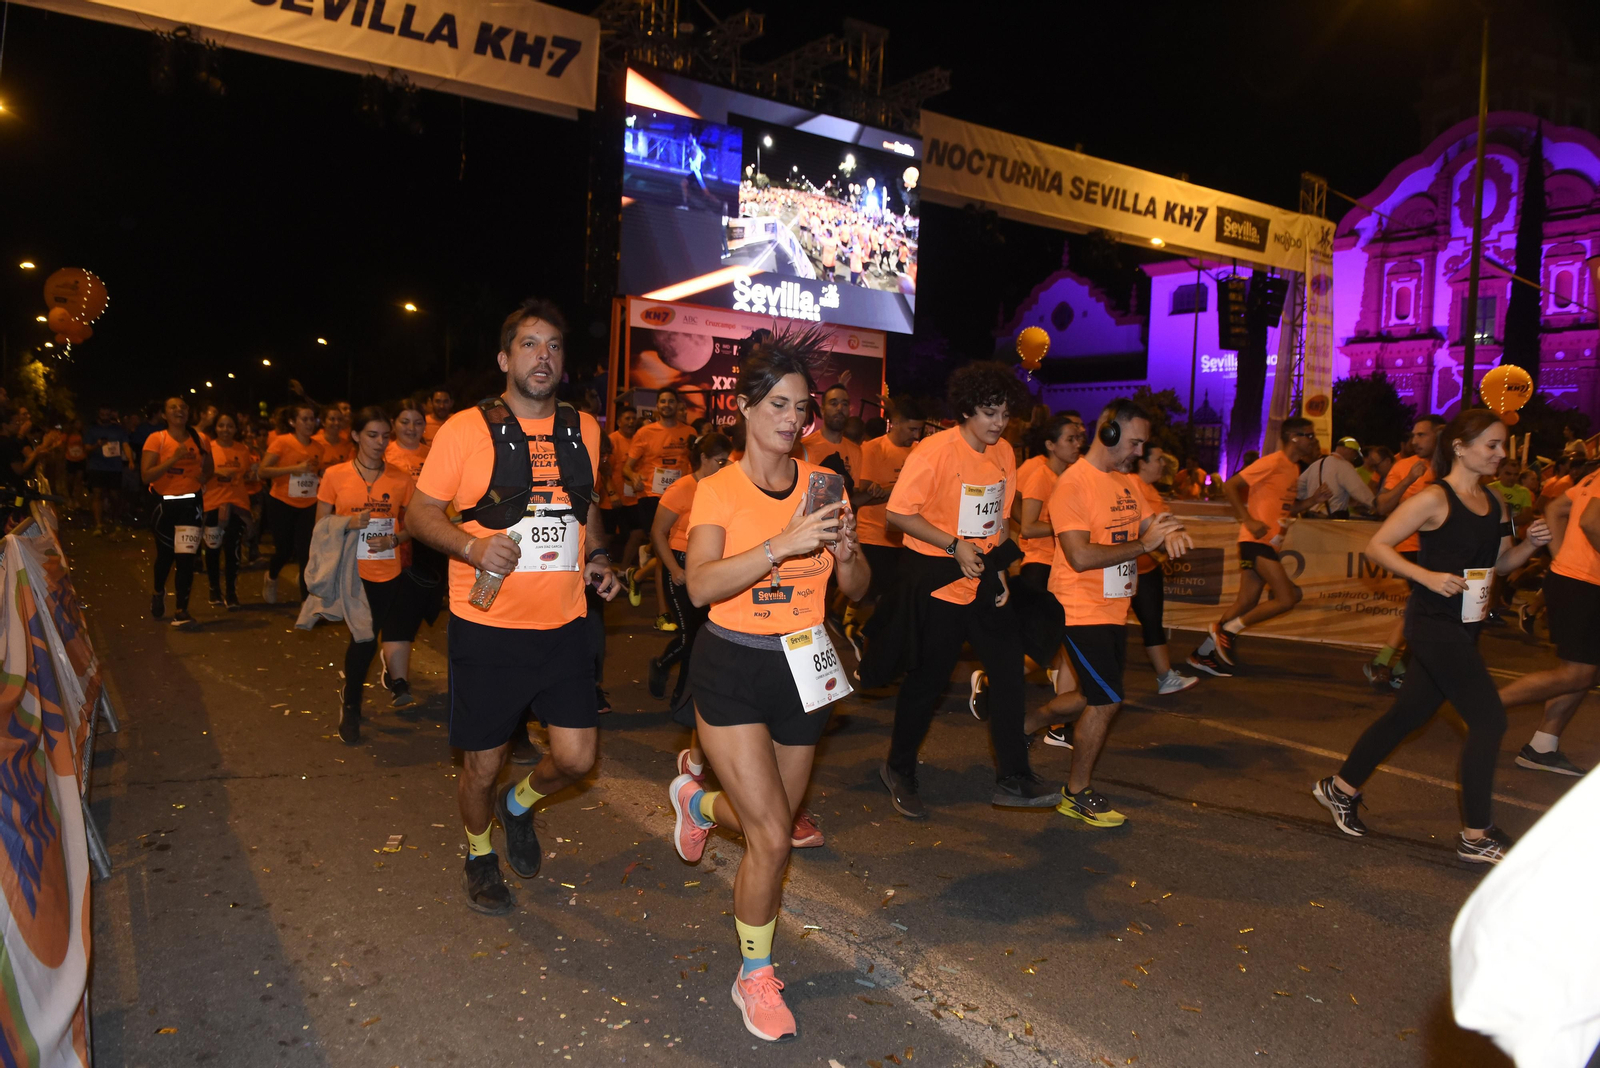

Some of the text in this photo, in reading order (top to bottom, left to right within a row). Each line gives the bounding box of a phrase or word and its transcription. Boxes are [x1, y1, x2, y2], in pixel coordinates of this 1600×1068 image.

[926, 138, 1063, 196] NOCTURNA
[1069, 176, 1158, 219] SEVILLA
[531, 526, 567, 543] 8537
[1335, 601, 1352, 612] de
[813, 648, 837, 673] 8565
